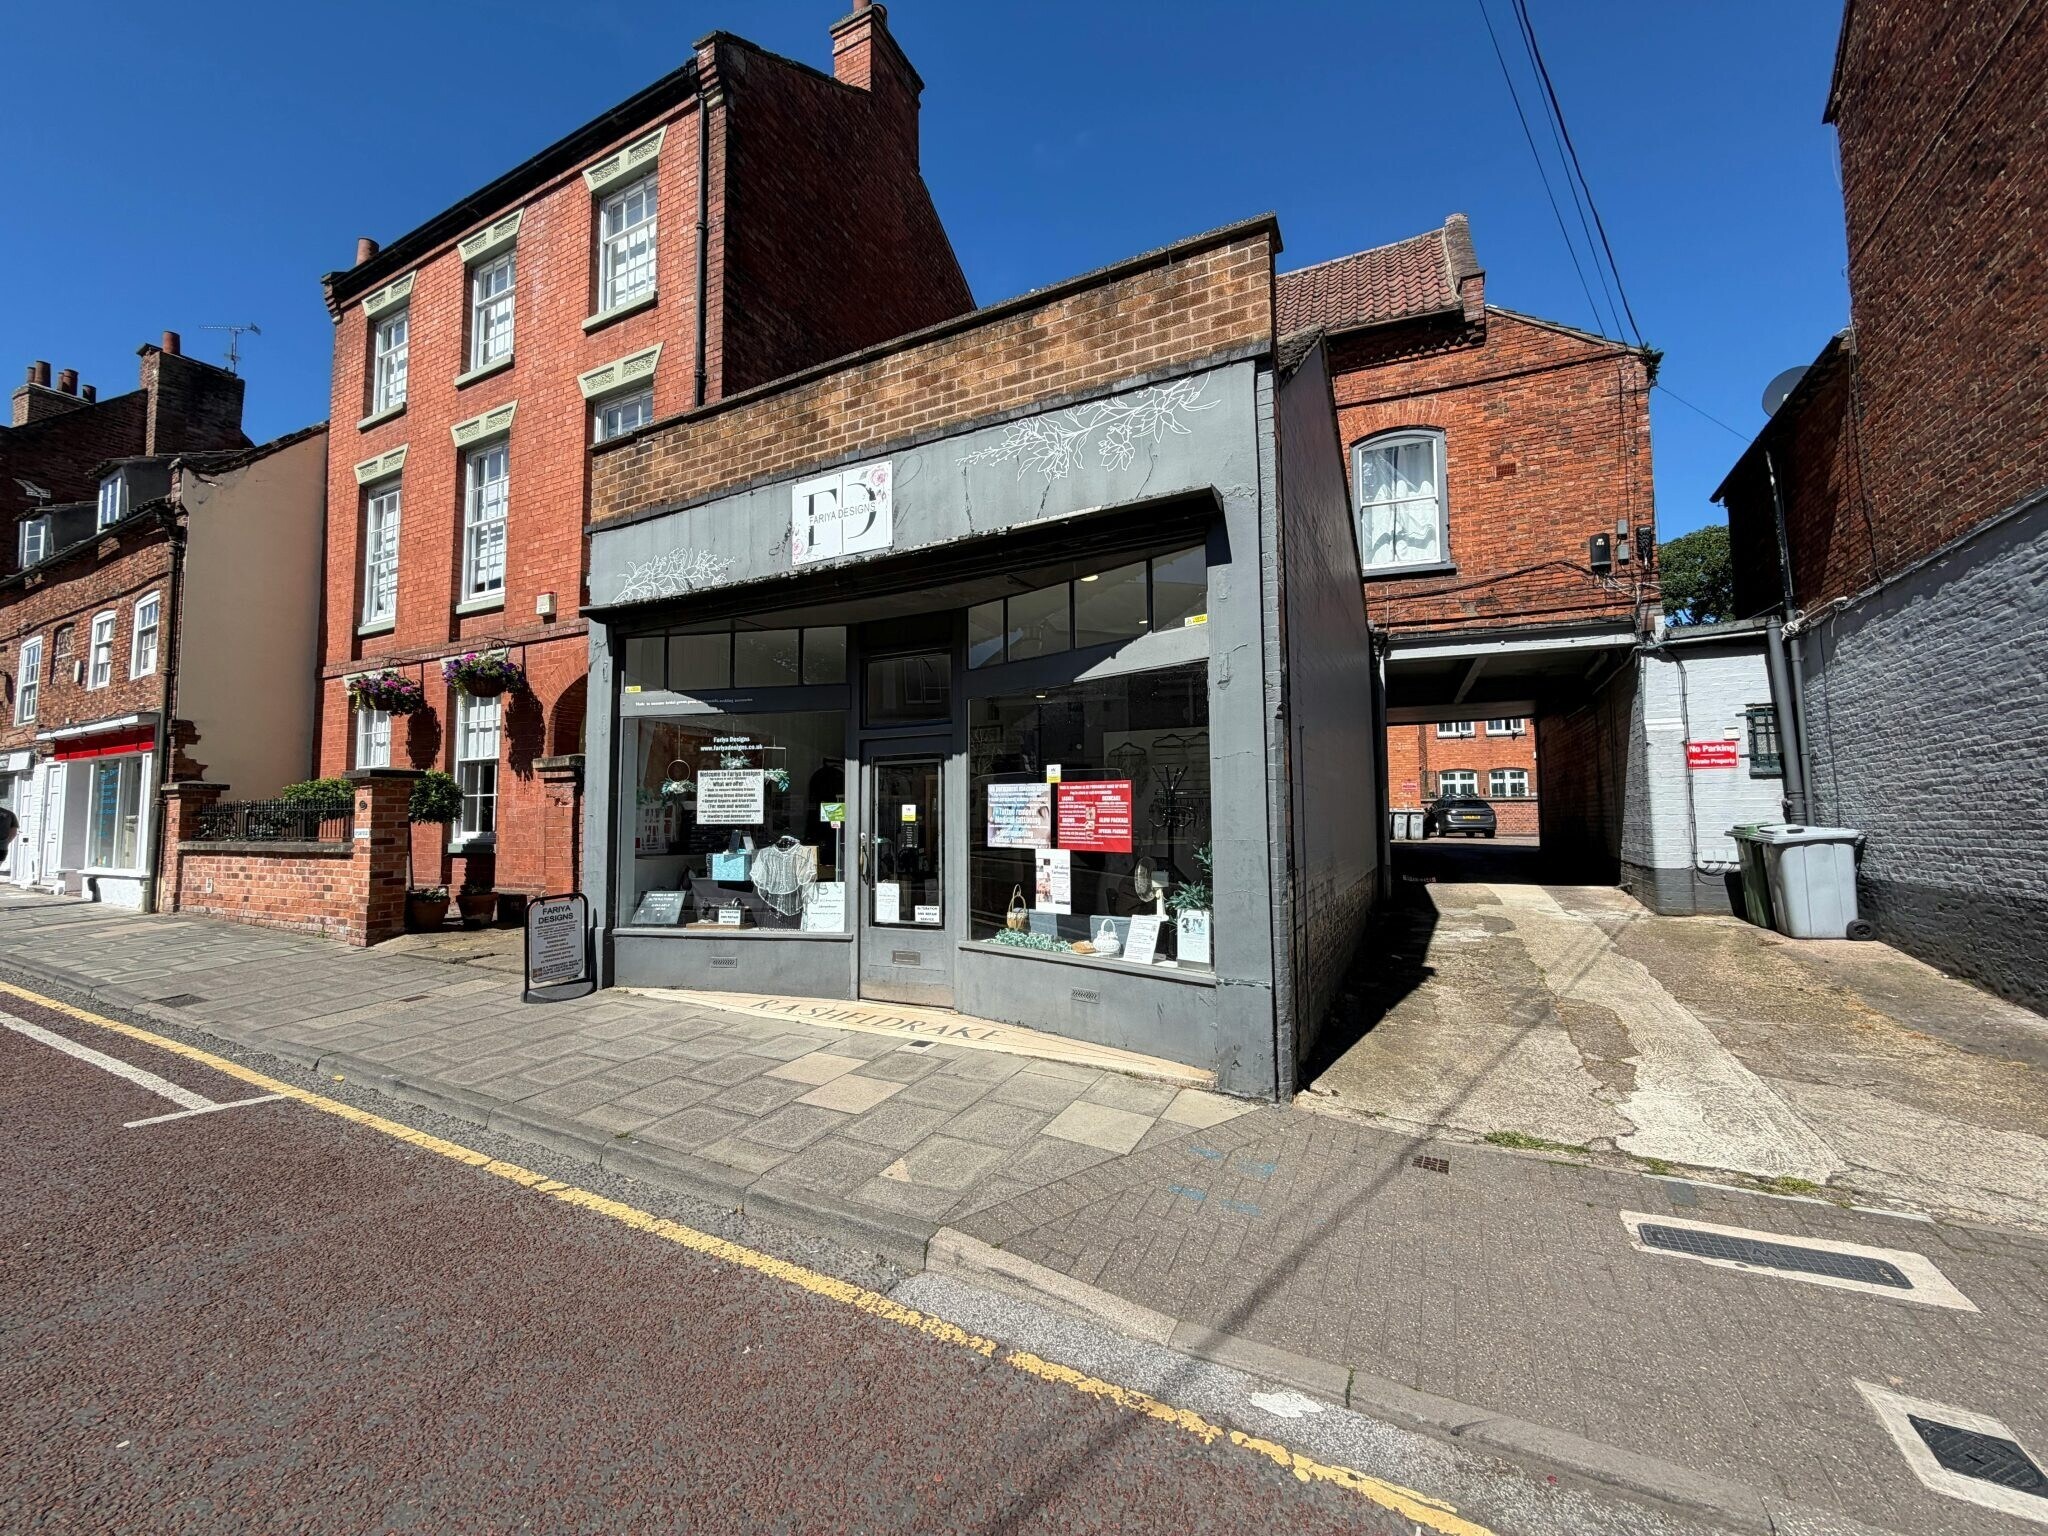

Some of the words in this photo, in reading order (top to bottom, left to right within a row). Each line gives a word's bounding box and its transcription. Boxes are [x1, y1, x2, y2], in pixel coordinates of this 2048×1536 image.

[809, 510, 837, 525] FARIYA
[837, 501, 876, 519] DESIGNS
[729, 735, 750, 743] Designs
[700, 743, 763, 752] www.fariyadesigns.co.uk
[1689, 745, 1701, 753] No
[1702, 744, 1735, 753] Parking
[1710, 757, 1736, 765] Property
[542, 904, 571, 915] FARIYA
[538, 912, 574, 925] DESIGNS
